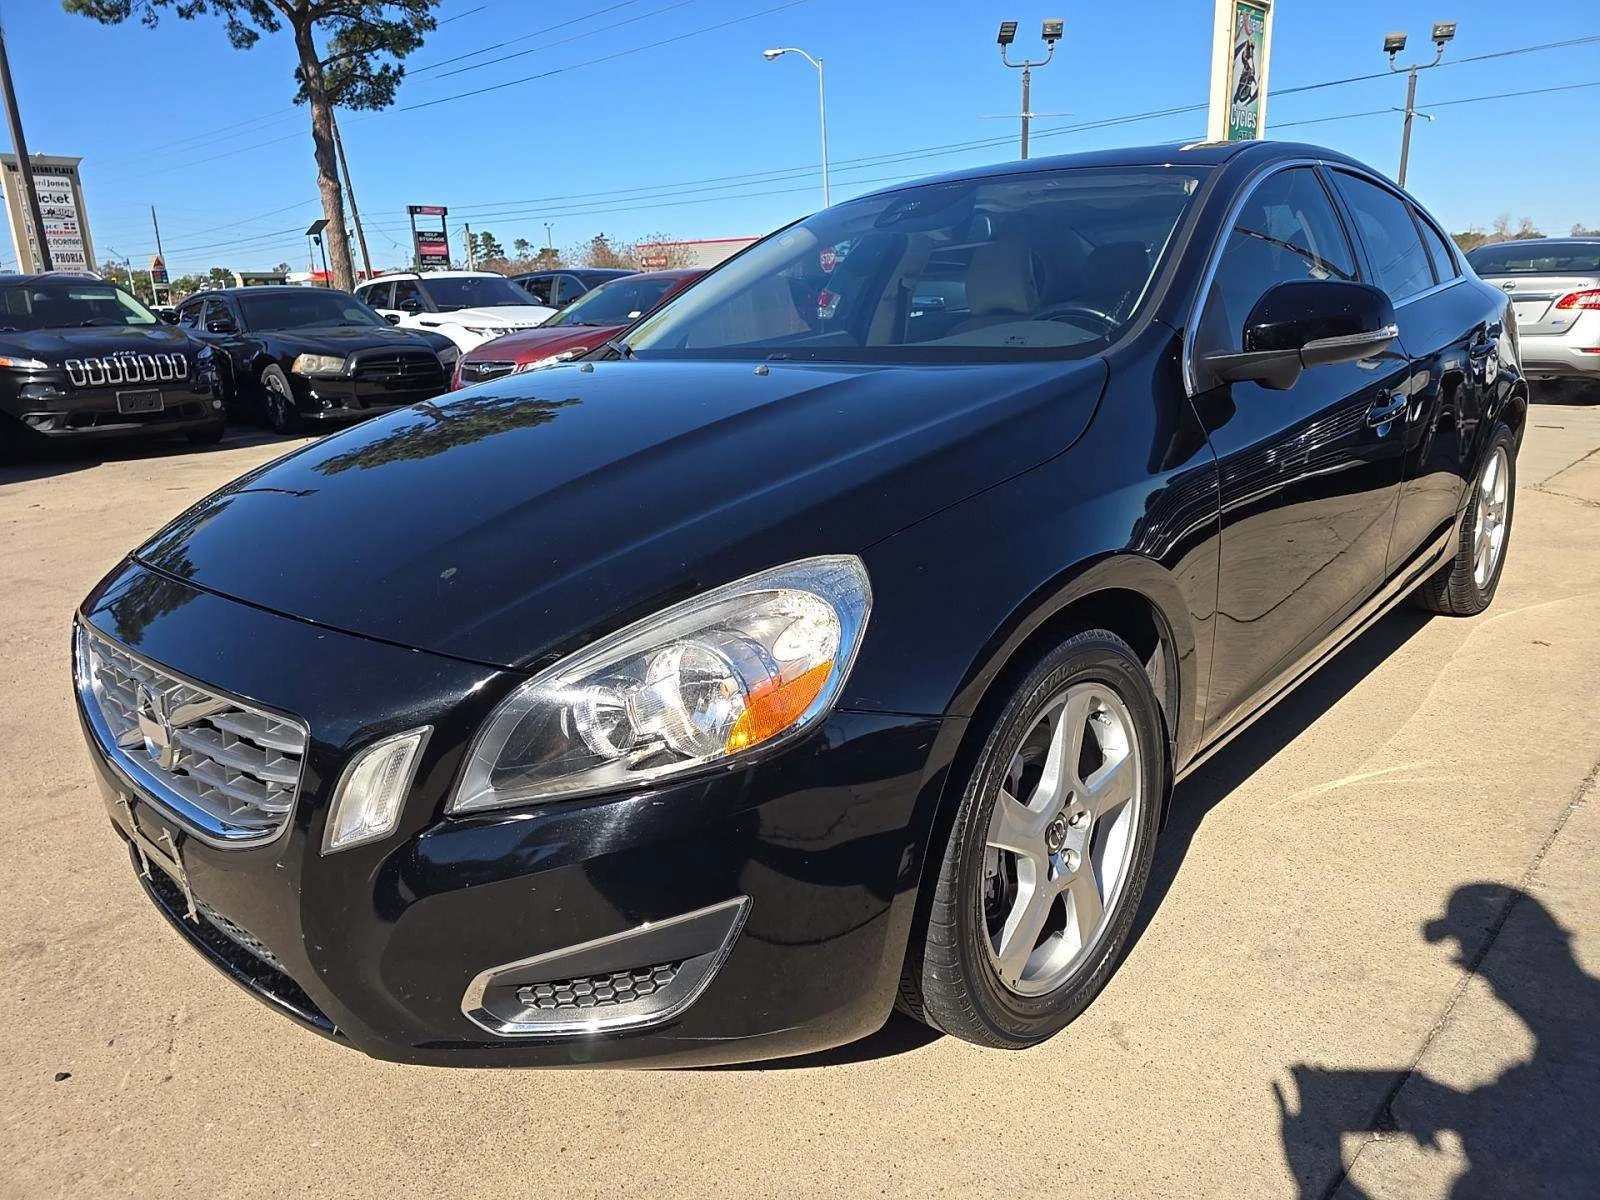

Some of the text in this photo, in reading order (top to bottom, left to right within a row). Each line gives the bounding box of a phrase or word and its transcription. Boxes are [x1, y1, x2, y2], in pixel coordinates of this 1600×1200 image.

[1231, 104, 1257, 130] Cycles
[38, 192, 70, 204] icket
[820, 253, 836, 265] STOP
